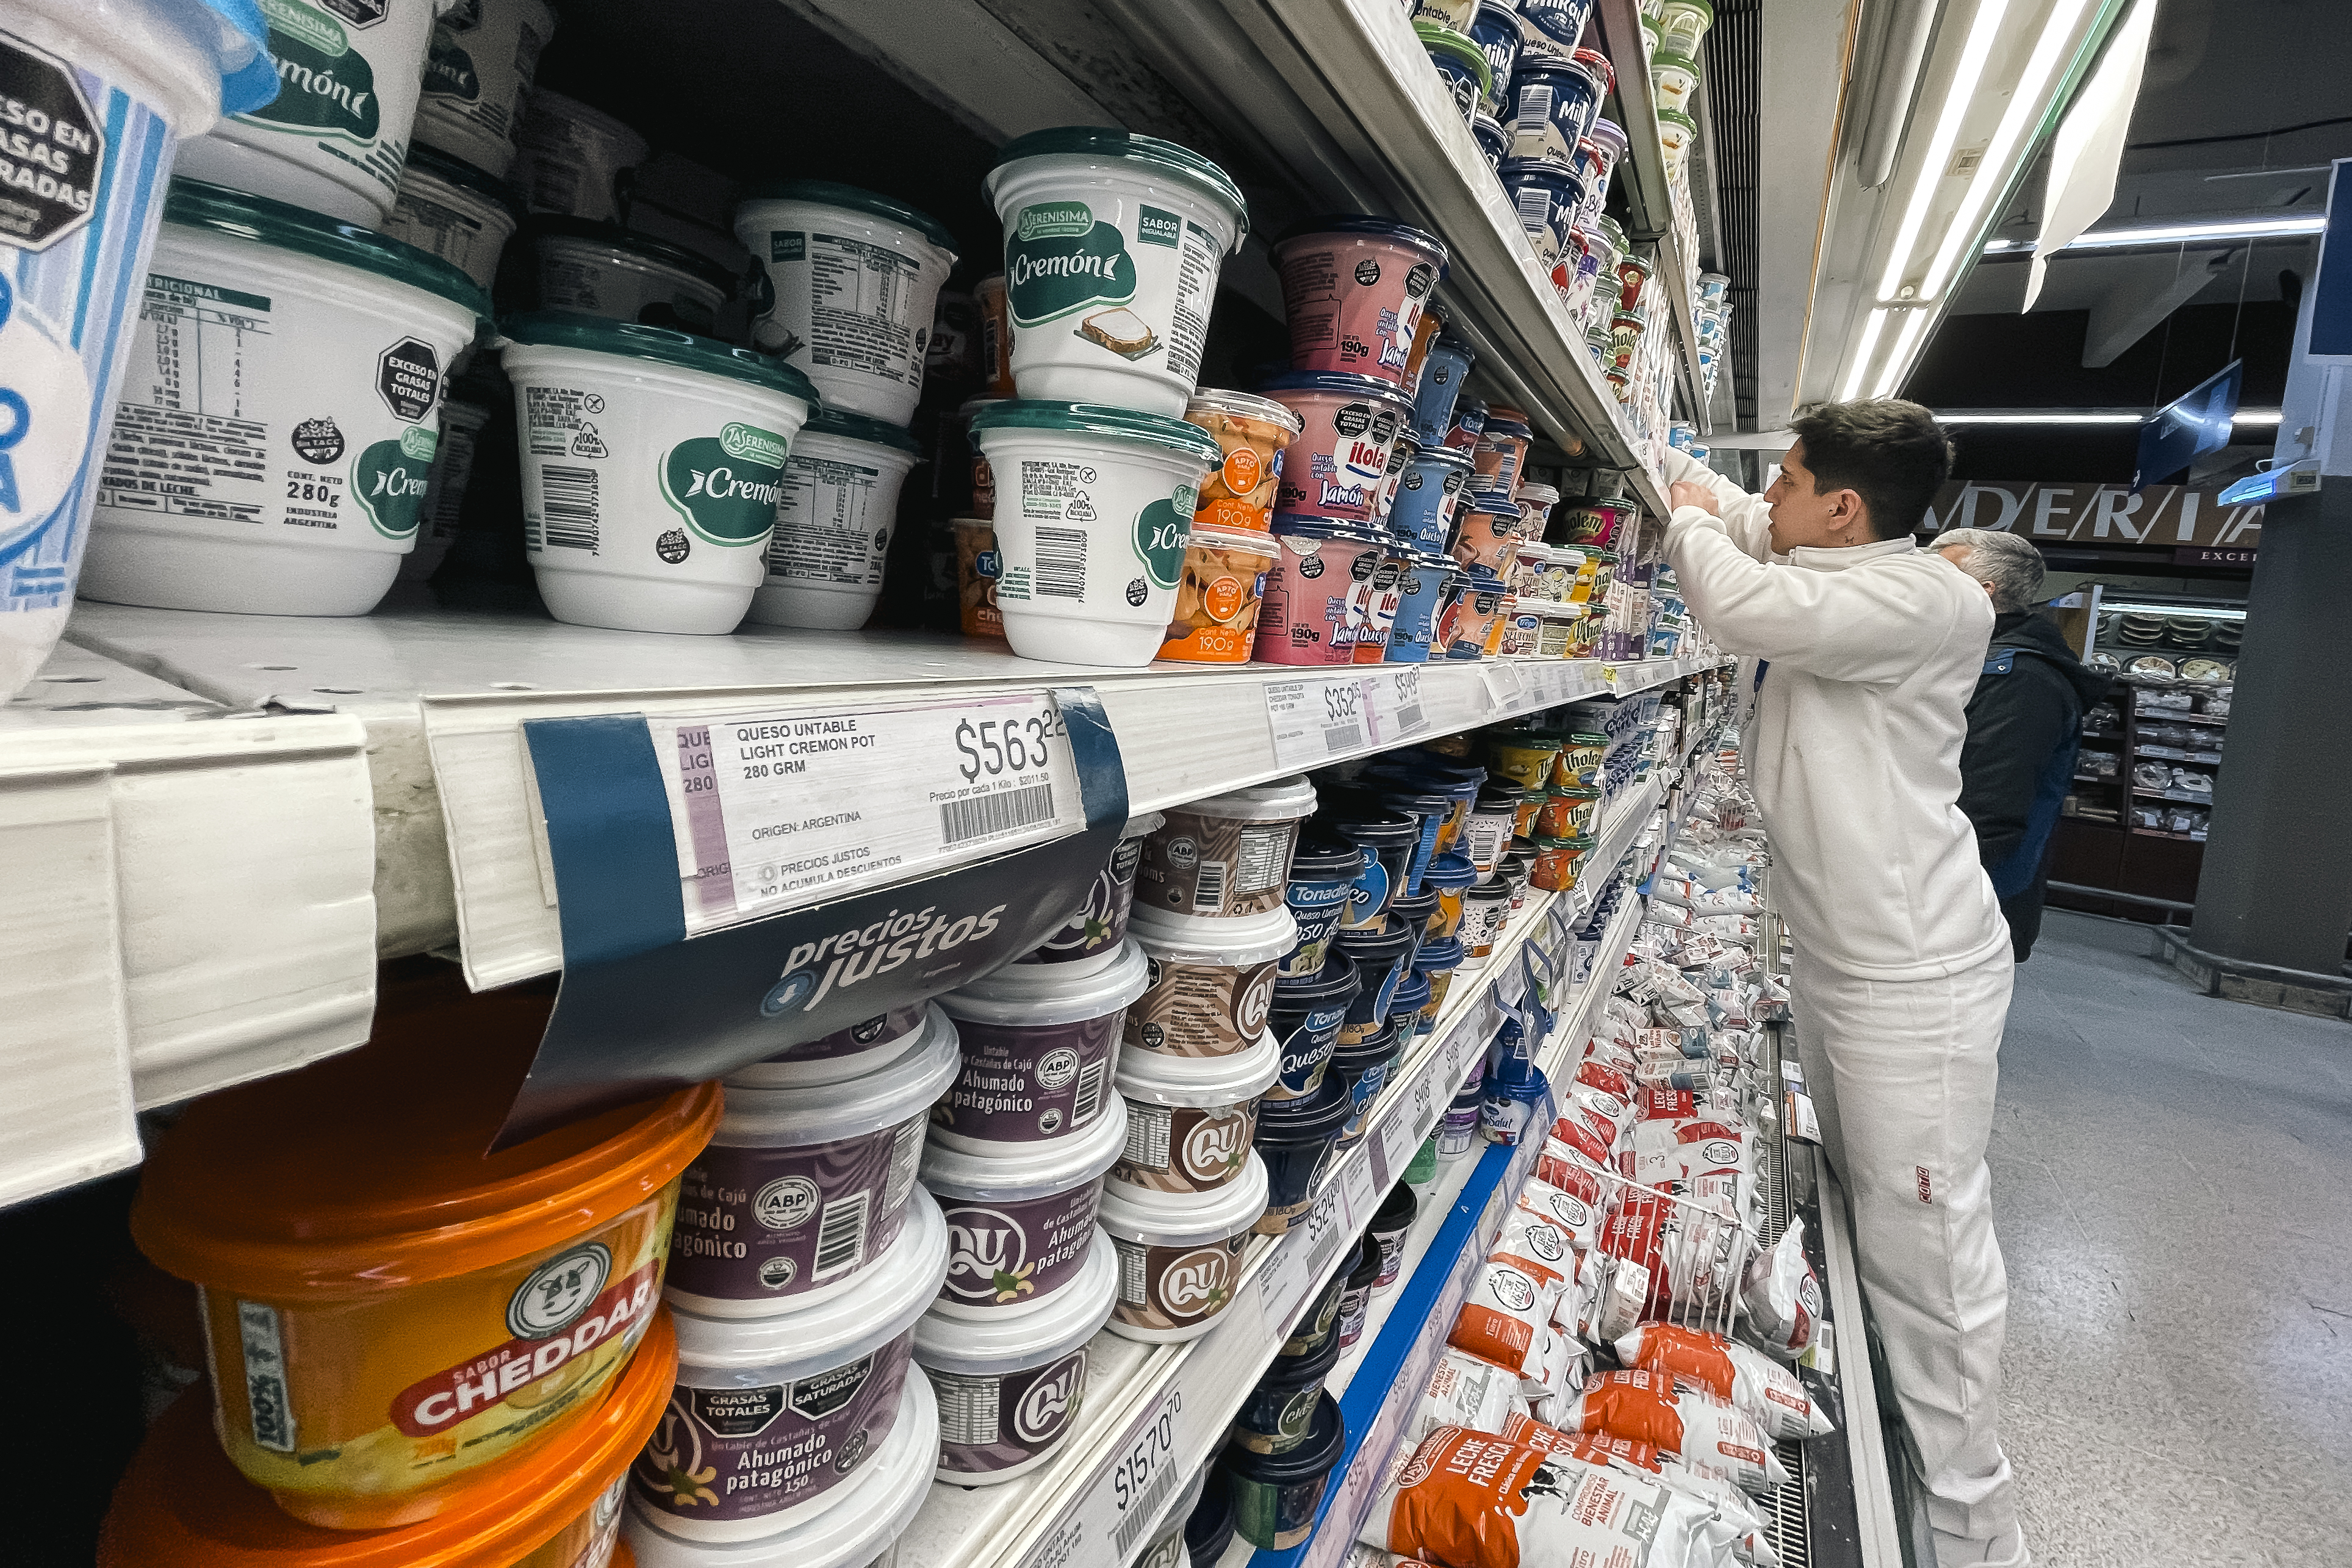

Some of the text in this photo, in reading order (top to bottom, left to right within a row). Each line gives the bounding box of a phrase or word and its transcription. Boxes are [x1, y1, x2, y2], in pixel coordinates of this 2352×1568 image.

[1142, 217, 1178, 232] SABOR
[1015, 248, 1101, 285] Cremón
[1340, 340, 1369, 358] 190g
[389, 356, 426, 376] EXCESO
[390, 383, 430, 403] TOTALES
[396, 372, 431, 391] GRASAS
[1235, 457, 1255, 469] APTO
[287, 481, 340, 508] 280g
[1318, 479, 1364, 506] Jamón
[1217, 508, 1251, 527] 190g
[1216, 586, 1237, 595] APTO
[1198, 636, 1234, 651] 190g
[1291, 628, 1320, 642] 190g
[1325, 686, 1356, 721] $352
[736, 719, 857, 742] QUESO UNTABLE
[740, 734, 875, 761] LIGHT CREMON POT
[743, 760, 806, 780] 280 GRM
[683, 775, 713, 793] 280
[929, 791, 956, 802] Precio
[958, 788, 970, 799] por
[972, 783, 990, 794] cada
[1018, 772, 1049, 786] $2011.50
[802, 811, 862, 832] ARGENTINA
[780, 846, 871, 876] PRECIOS JUSTOS
[761, 855, 902, 897] NO ACUMULA DESCUENTOS
[780, 906, 937, 980] precios
[803, 904, 1007, 1012] justos
[1003, 1059, 1012, 1069] de
[1013, 1058, 1032, 1072] Cajú
[1046, 1060, 1070, 1073] ABP
[1282, 1040, 1334, 1074] Queso
[962, 1070, 1025, 1091] Ahumado
[954, 1091, 1033, 1115] patagónico
[718, 1187, 747, 1204] Cajú
[769, 1194, 806, 1209] ABP
[1043, 1218, 1054, 1230] de
[414, 1279, 651, 1426] CHEDDAR
[453, 1349, 511, 1384] SABOR
[811, 1366, 858, 1390] GRASAS
[795, 1367, 869, 1405] SATURADAS
[706, 1404, 771, 1417] TOTALES
[710, 1394, 767, 1404] GRASAS
[737, 1434, 826, 1470] Ahumado
[1445, 1438, 1489, 1475] LECHE
[726, 1448, 833, 1495] patagónico
[1467, 1442, 1515, 1487] FRESCA
[785, 1474, 809, 1494] 150
[1572, 1473, 1598, 1521] COMPROMISO
[1581, 1475, 1609, 1527] BIENESTAR
[1595, 1489, 1618, 1526] ANIMAL
